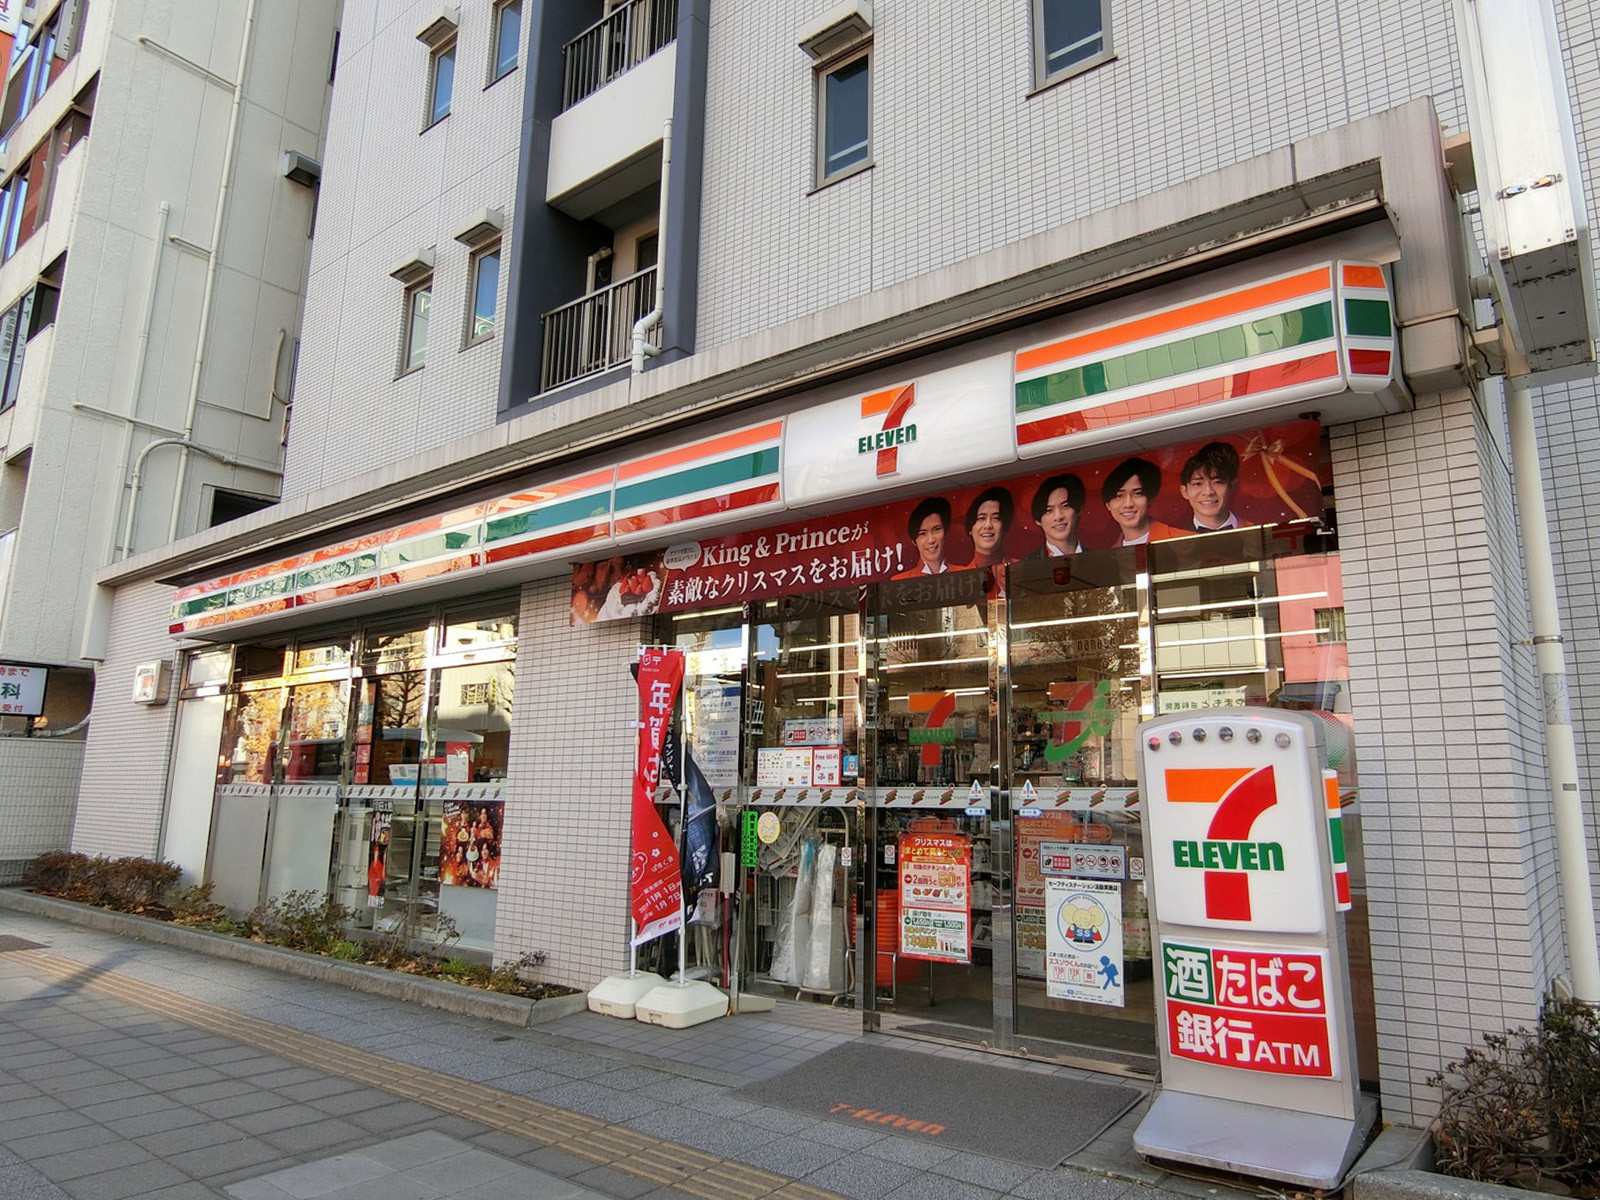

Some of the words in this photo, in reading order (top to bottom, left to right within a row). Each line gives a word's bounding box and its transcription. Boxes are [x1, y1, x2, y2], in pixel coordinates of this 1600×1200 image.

[862, 382, 915, 475] 7
[667, 542, 904, 606] 素敵なクリスマスをお届け!
[701, 543, 751, 568] King
[754, 536, 770, 558] &
[774, 521, 869, 555] Princeが
[915, 838, 953, 848] クリスマスは
[1165, 764, 1278, 921] 7
[1166, 947, 1209, 1000] 酒
[1216, 954, 1321, 1008] たばこ
